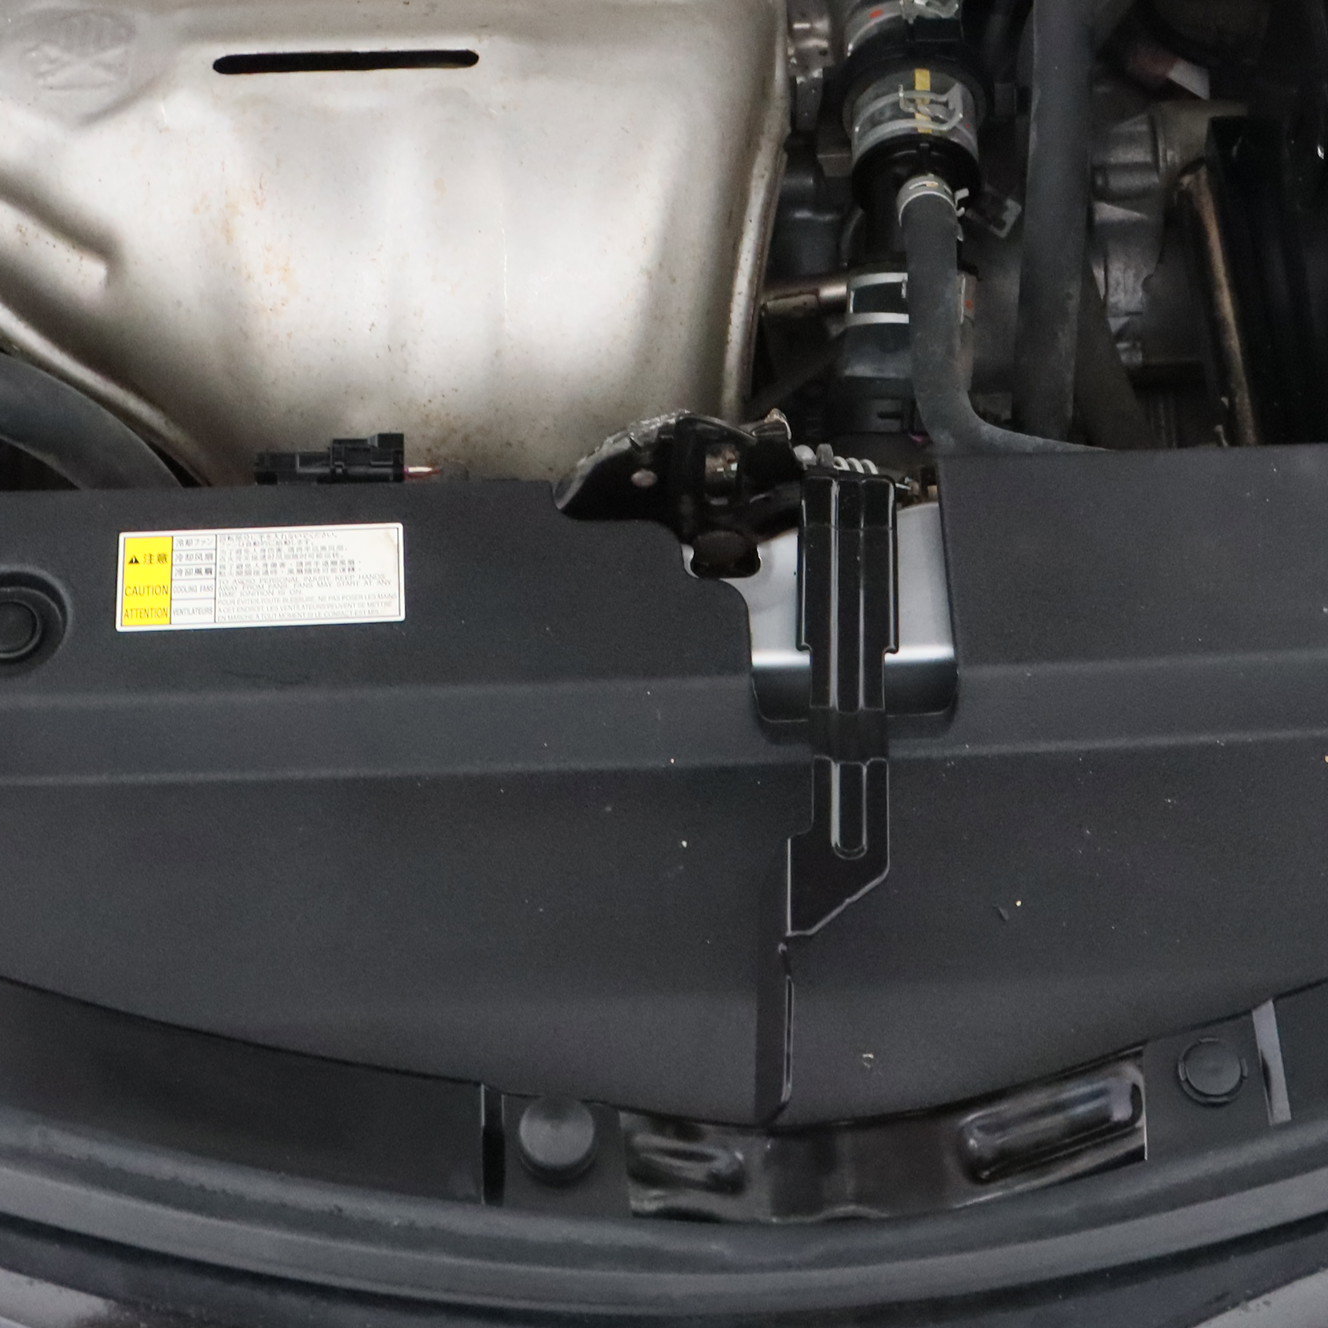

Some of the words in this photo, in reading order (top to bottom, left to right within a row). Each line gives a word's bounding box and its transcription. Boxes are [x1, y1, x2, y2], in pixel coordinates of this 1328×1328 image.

[143, 553, 168, 565] 注意
[125, 585, 169, 597] CAUTION
[124, 607, 169, 619] ATTENTION
